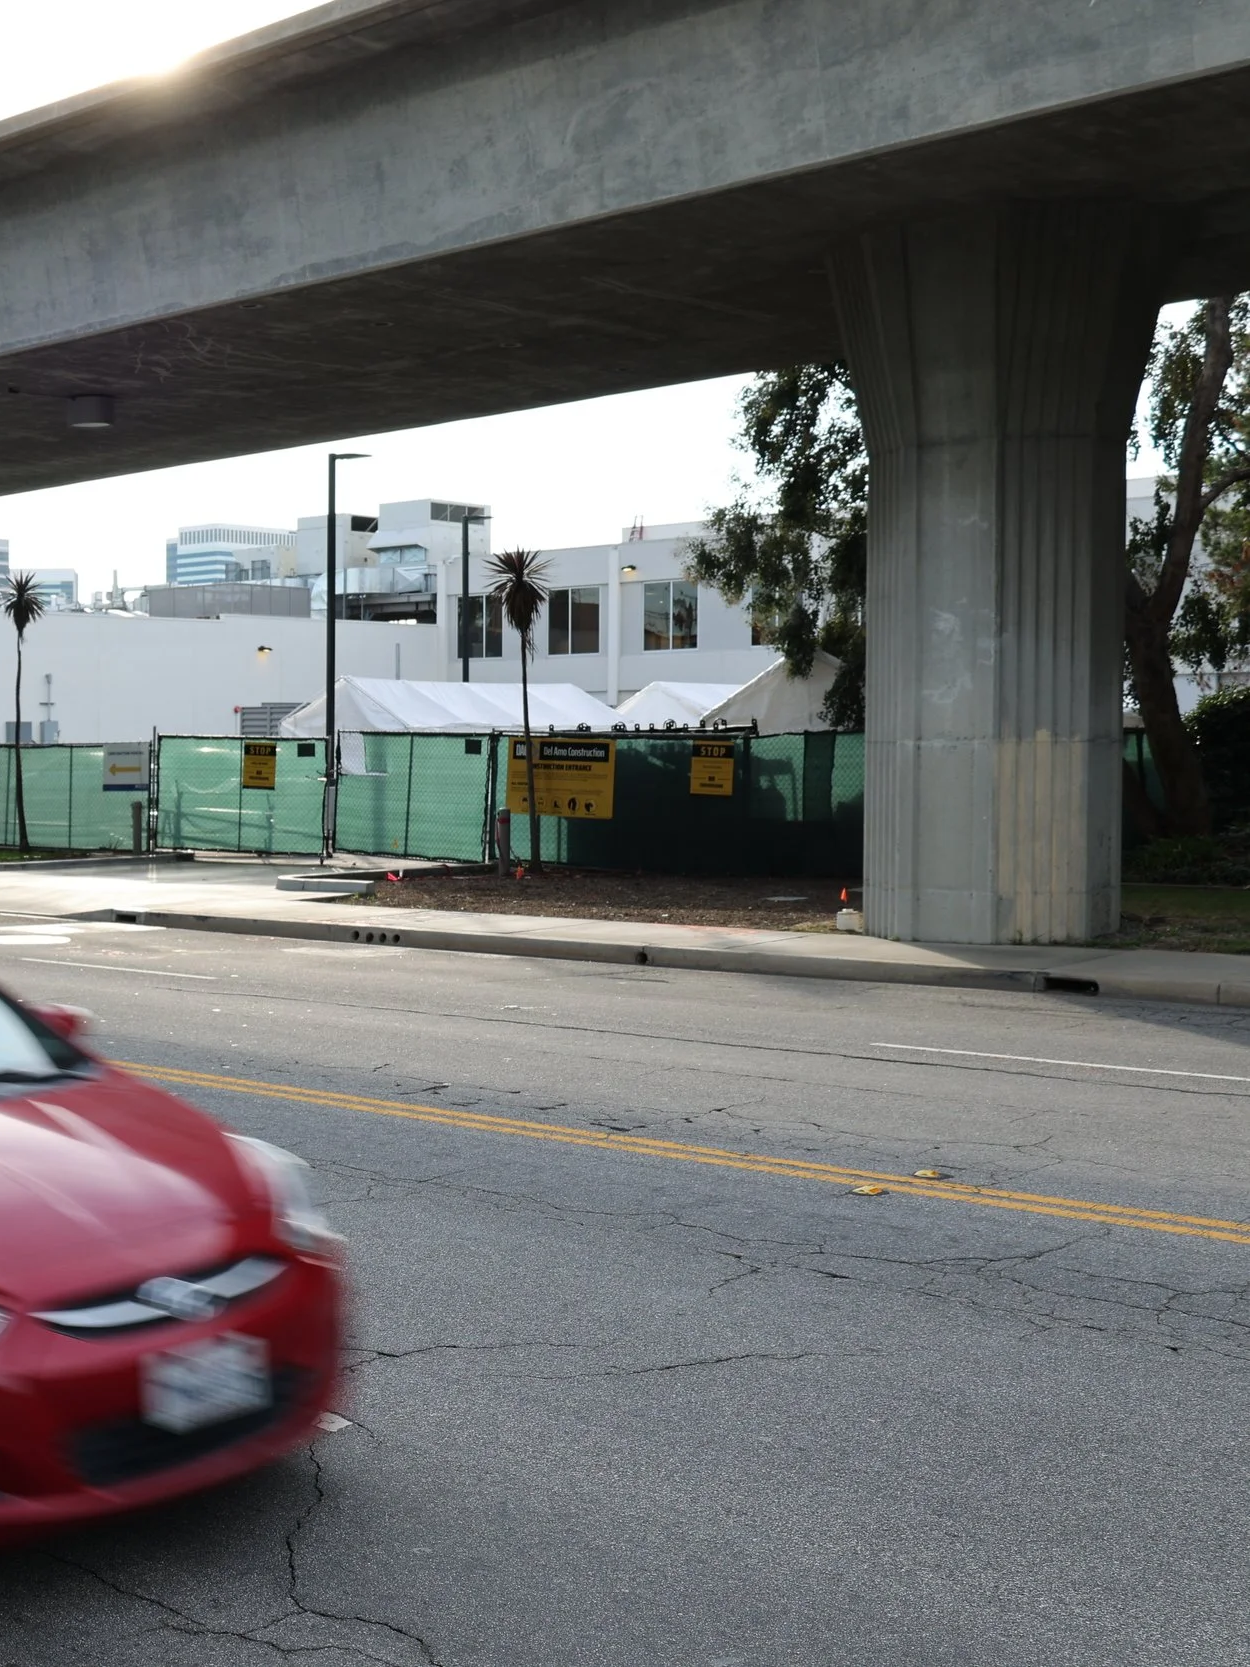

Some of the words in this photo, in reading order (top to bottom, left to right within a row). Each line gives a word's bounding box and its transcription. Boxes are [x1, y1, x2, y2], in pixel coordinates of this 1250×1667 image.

[250, 746, 271, 755] STOP
[543, 746, 553, 756] Del
[553, 746, 567, 756] Amo
[568, 747, 605, 757] Construction
[701, 746, 726, 756] STOP
